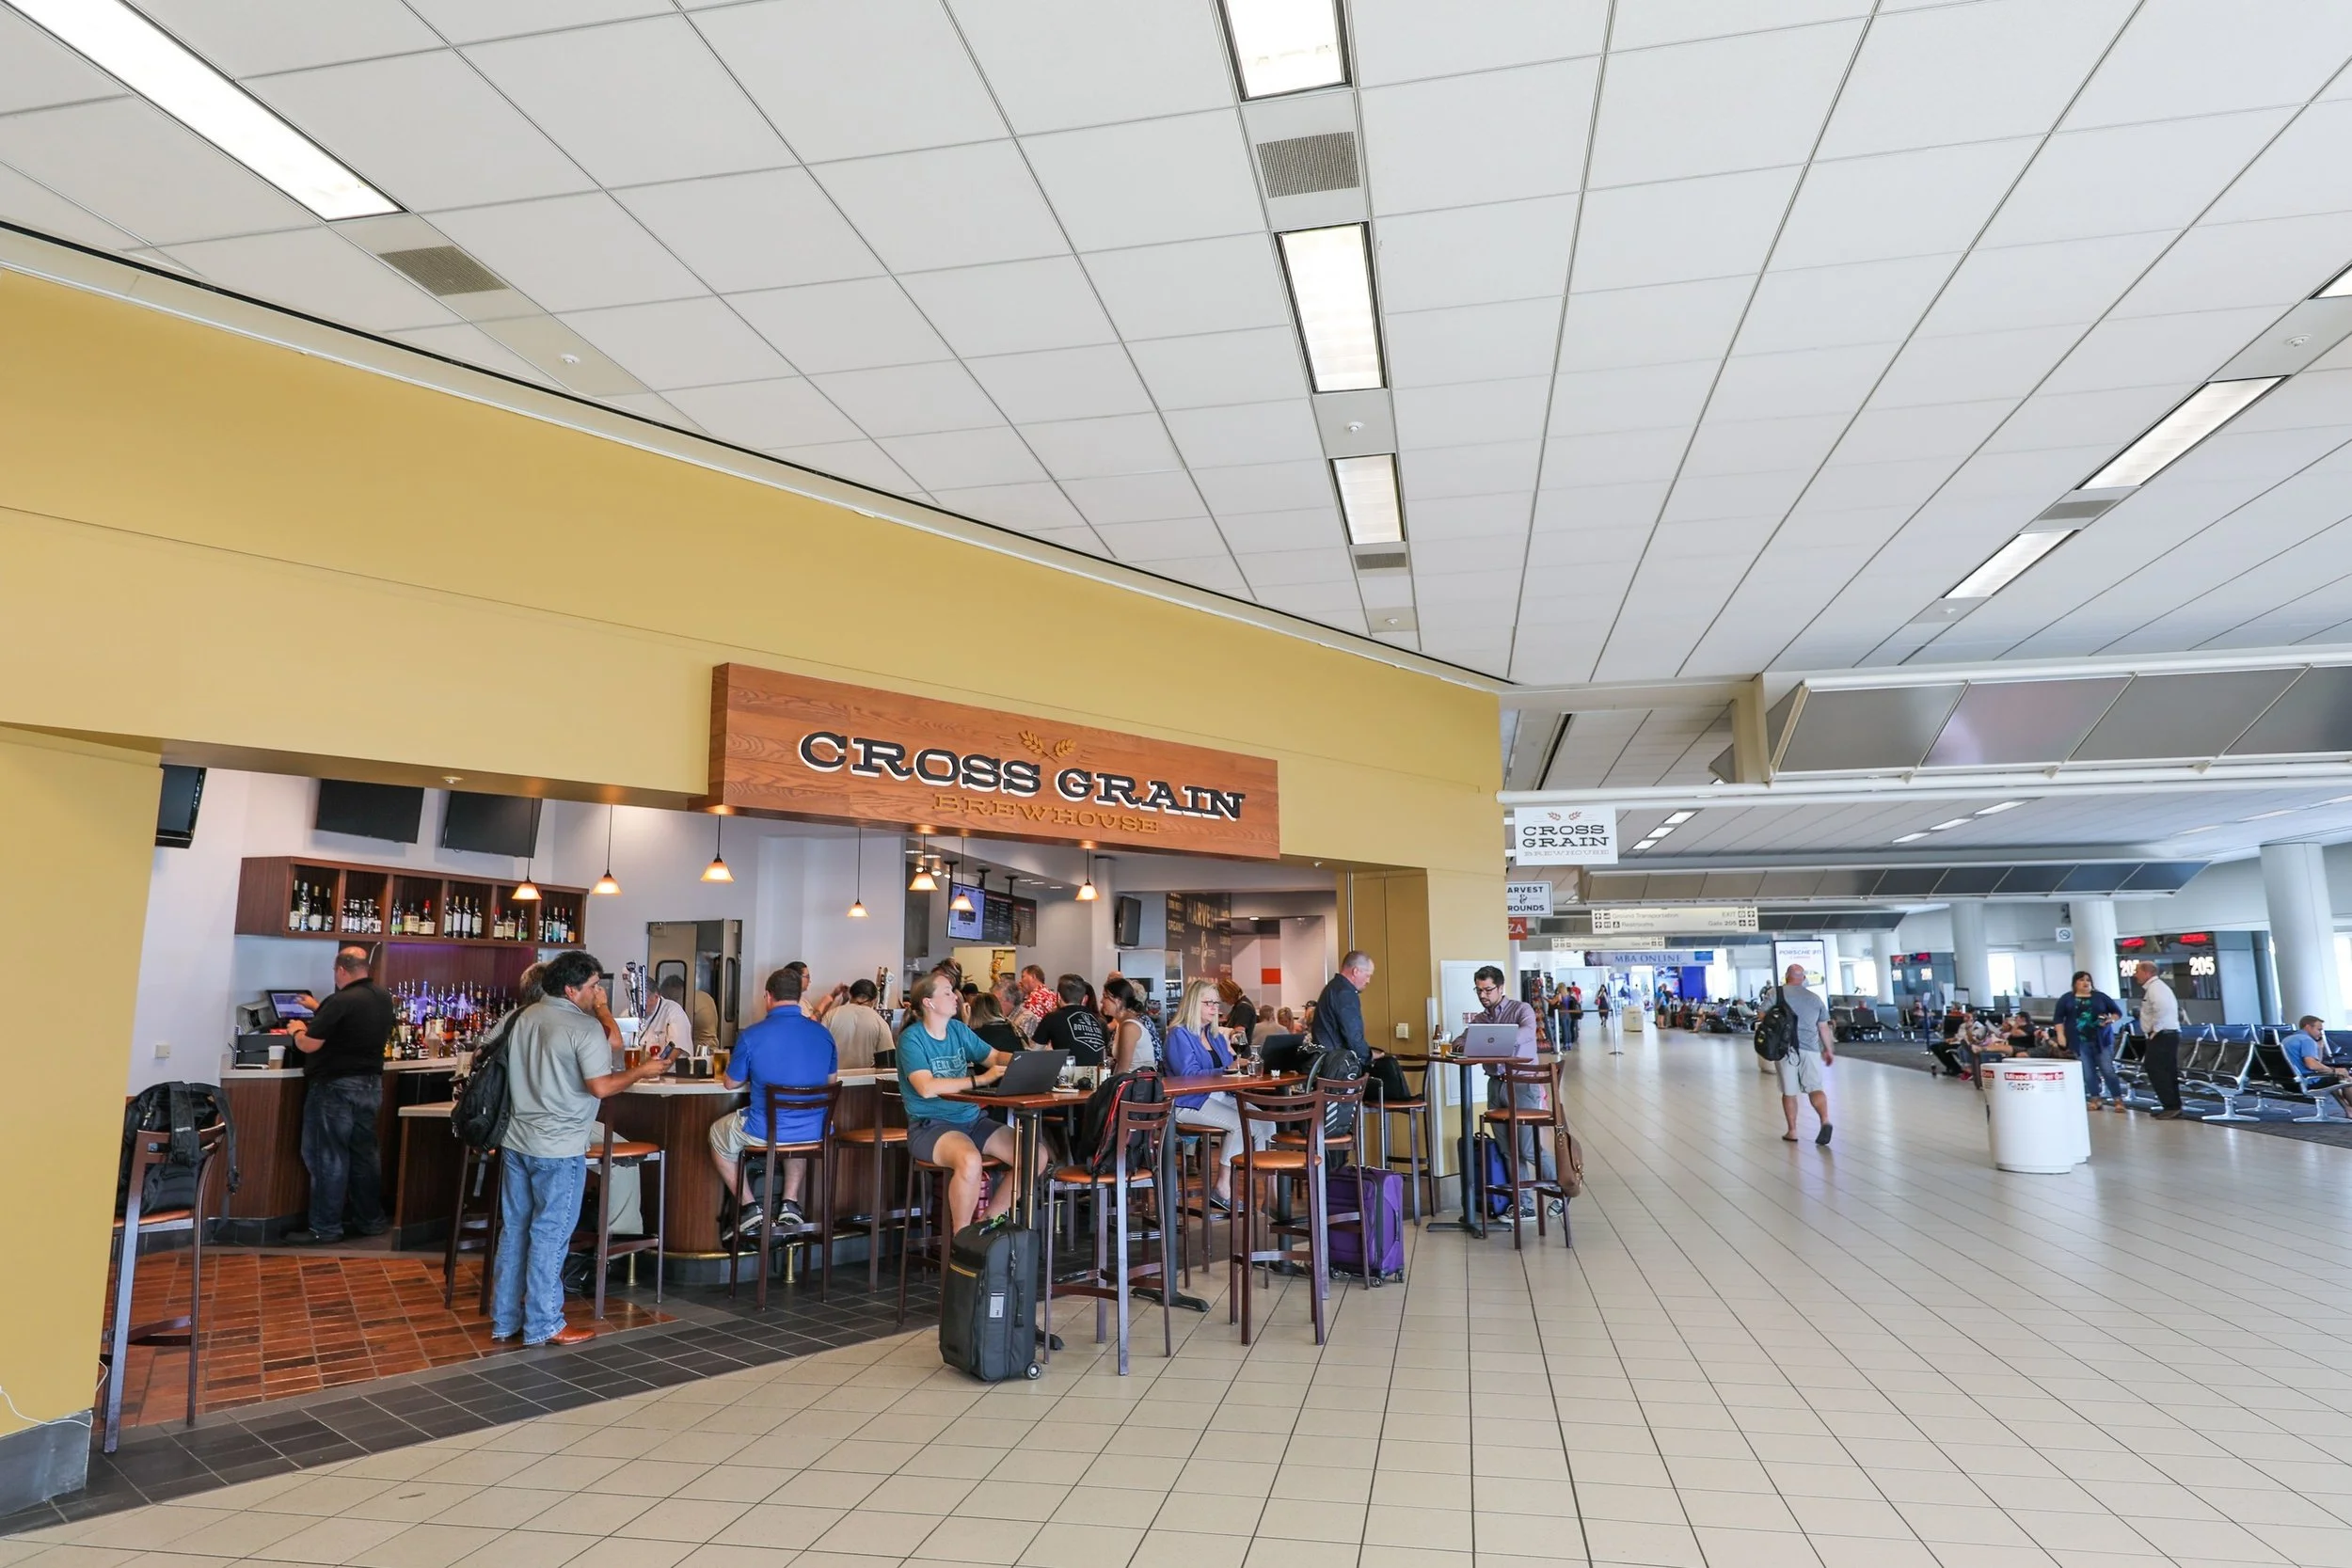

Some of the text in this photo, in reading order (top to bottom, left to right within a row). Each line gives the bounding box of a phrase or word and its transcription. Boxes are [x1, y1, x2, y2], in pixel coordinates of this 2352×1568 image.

[799, 731, 1246, 822] CROSS GRAIN
[931, 793, 1159, 833] BREWHOUSE
[1523, 824, 1605, 836] CROSS
[1522, 836, 1610, 847] GRAIN
[1636, 911, 1679, 920] Transportation
[1508, 924, 1525, 934] ZA
[1614, 954, 1682, 963] MBA ONLINE
[2188, 956, 2216, 975] 205
